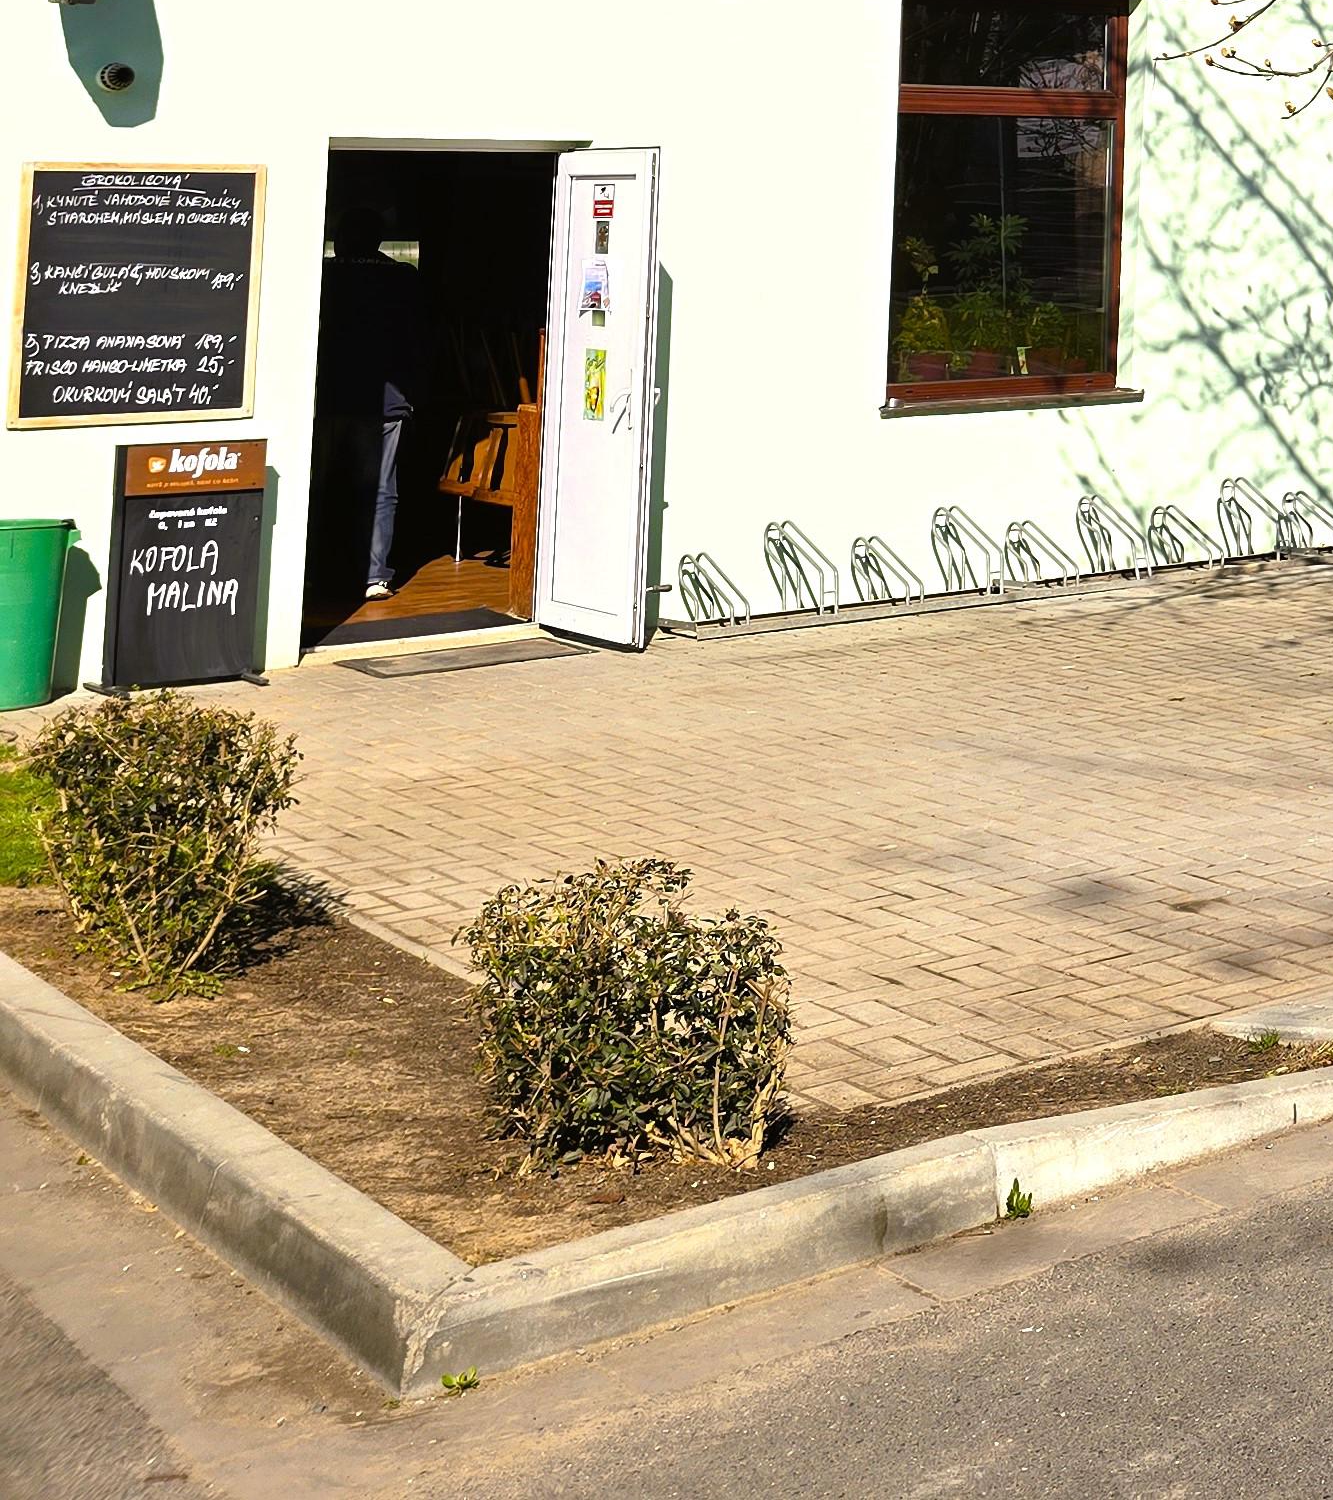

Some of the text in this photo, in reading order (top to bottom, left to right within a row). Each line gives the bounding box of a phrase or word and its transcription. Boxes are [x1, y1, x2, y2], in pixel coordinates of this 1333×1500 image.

[43, 333, 91, 351] PIZZA
[96, 333, 187, 350] ANANASOVÁ
[52, 380, 134, 404] OKURKOVÝ
[135, 383, 187, 405] SALÁT
[168, 446, 239, 478] kofola
[129, 539, 219, 576] KOFOLA
[146, 578, 239, 616] MALINA
